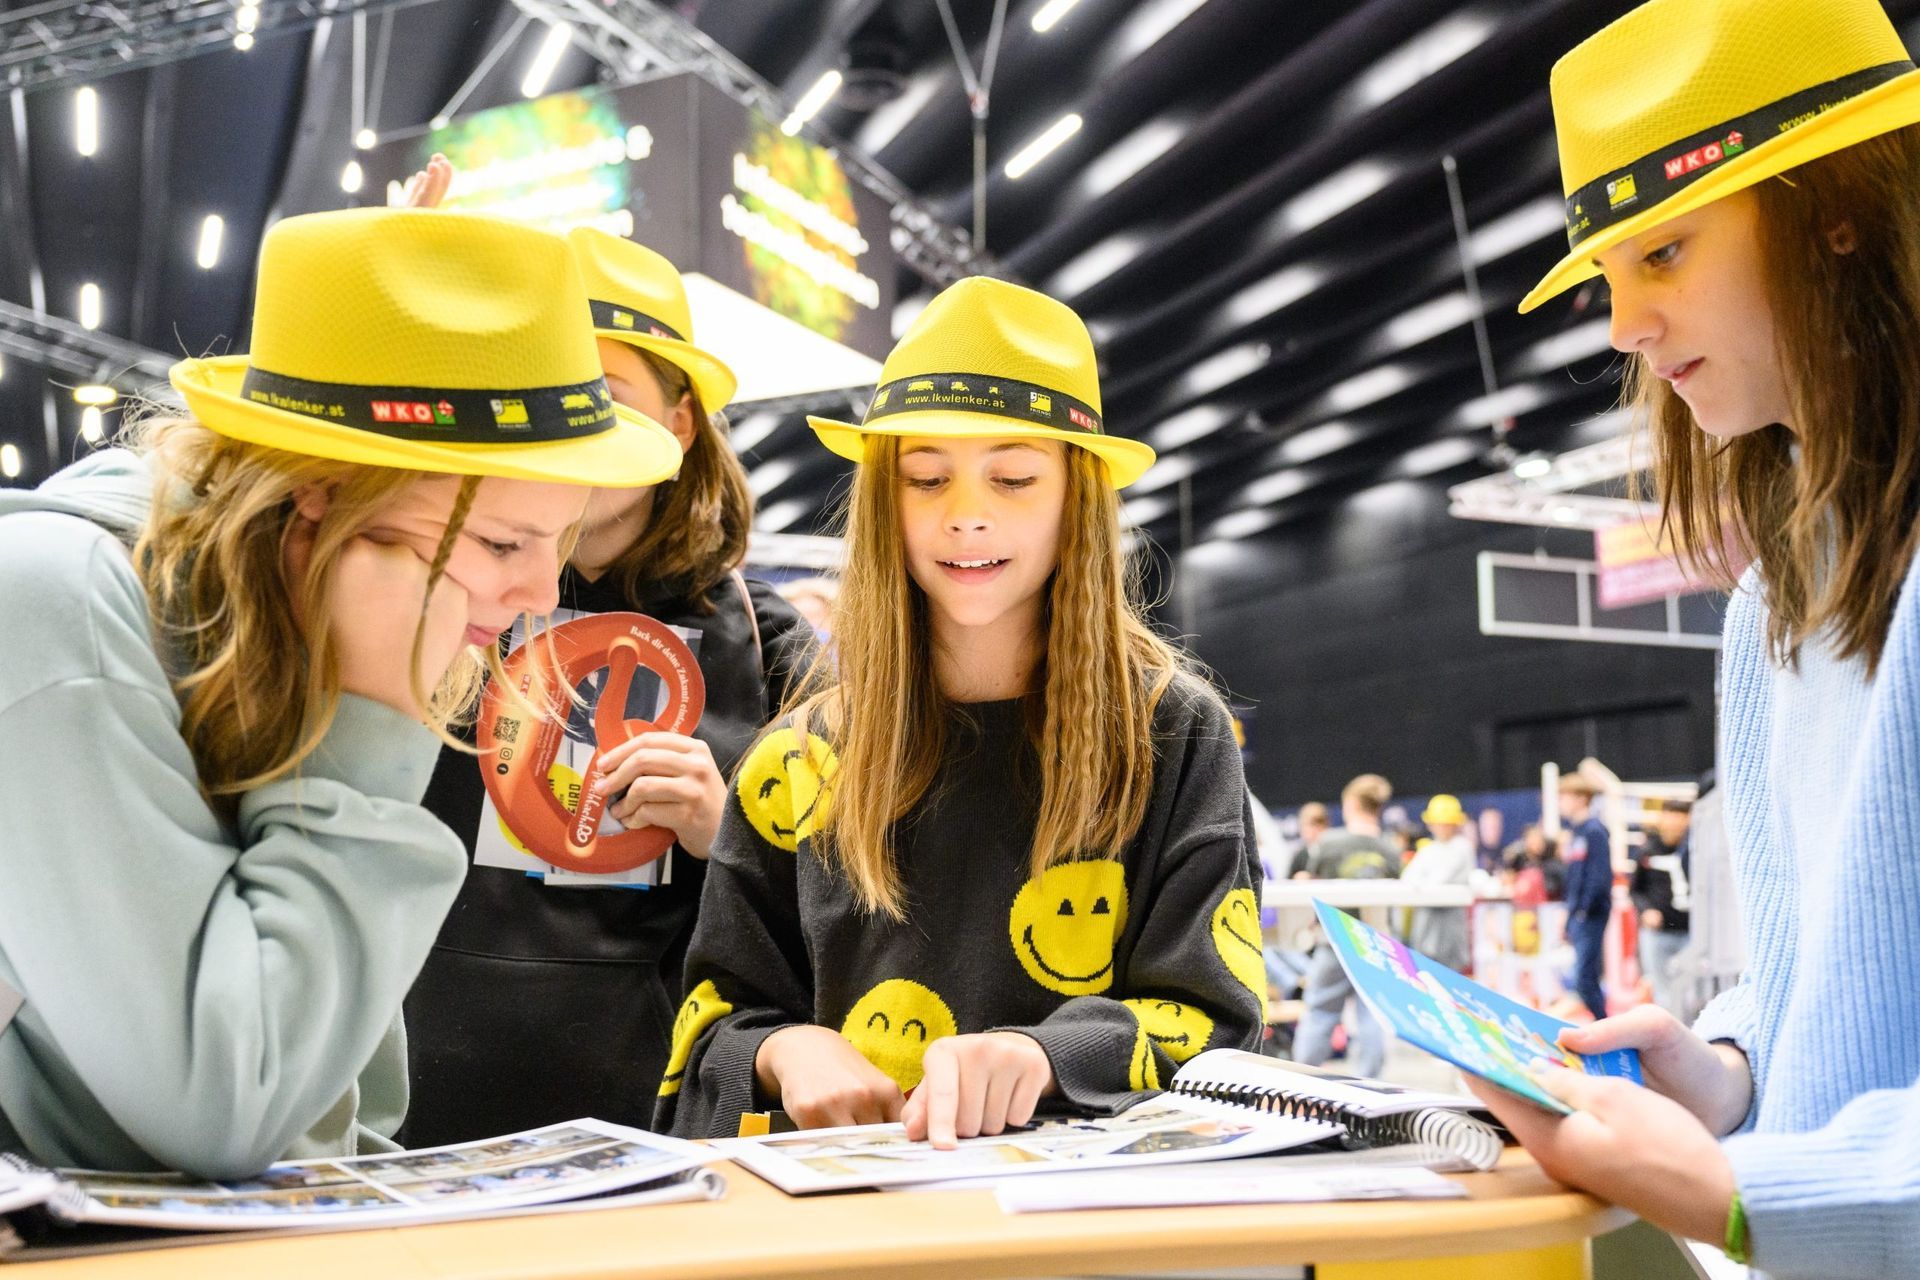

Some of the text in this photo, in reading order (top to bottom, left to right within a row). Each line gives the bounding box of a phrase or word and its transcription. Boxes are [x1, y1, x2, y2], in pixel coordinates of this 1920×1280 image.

[1665, 144, 1721, 178] WKO
[372, 402, 432, 422] WKO
[905, 393, 1006, 409] www.lkwlenker.at
[1069, 407, 1092, 431] WKO
[630, 626, 650, 642] Back
[651, 638, 664, 651] dir
[662, 648, 680, 669] deine
[676, 667, 689, 703] Zukunft
